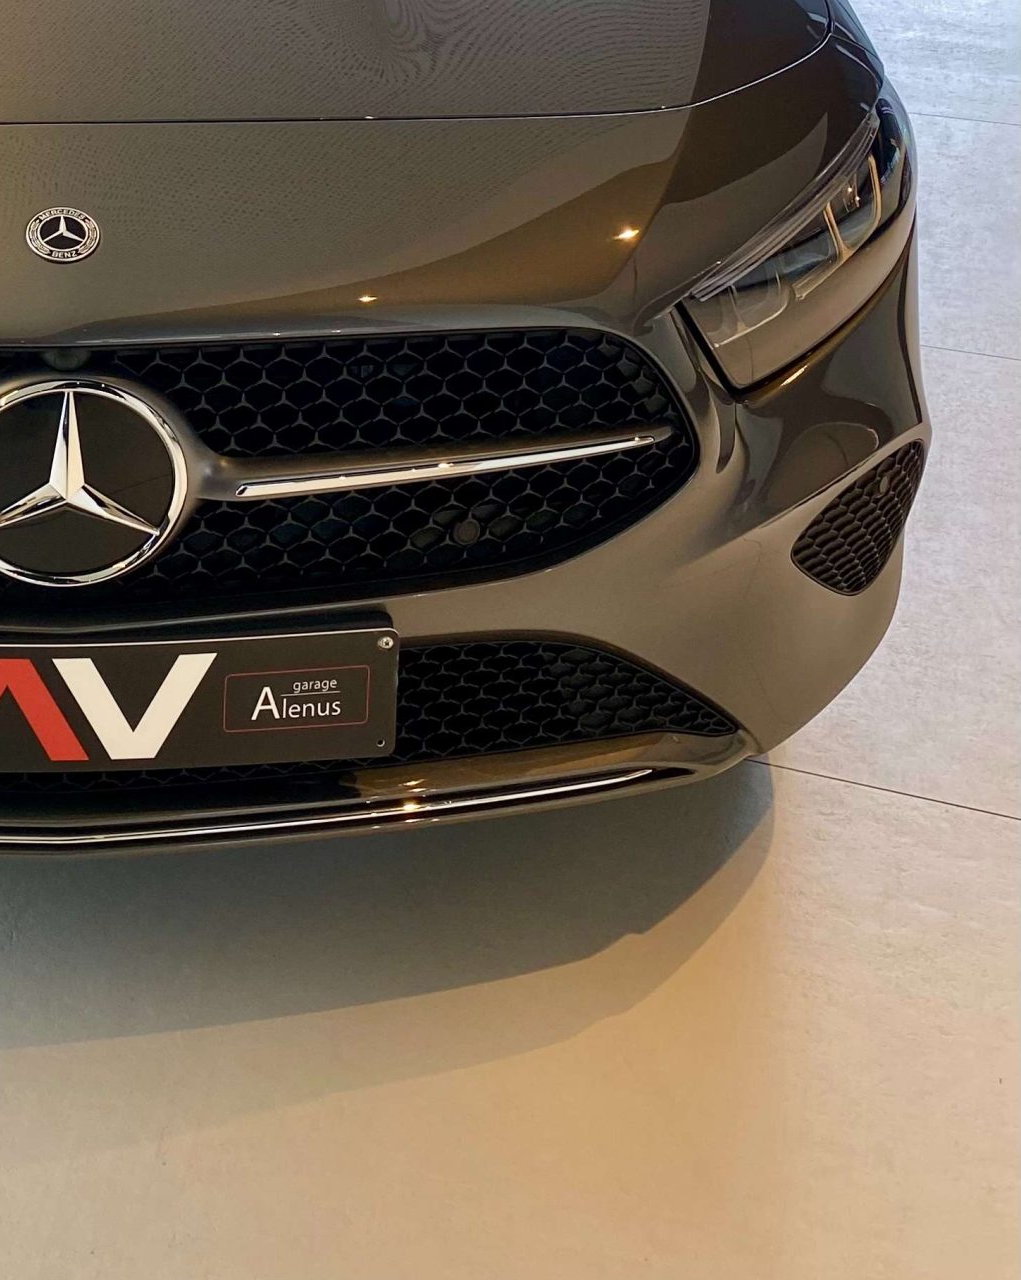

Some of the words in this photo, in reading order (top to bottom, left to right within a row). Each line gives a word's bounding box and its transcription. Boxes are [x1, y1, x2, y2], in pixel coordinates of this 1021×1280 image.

[39, 209, 85, 220] MERCEDES
[292, 679, 338, 694] garage
[251, 686, 341, 721] Alenus
